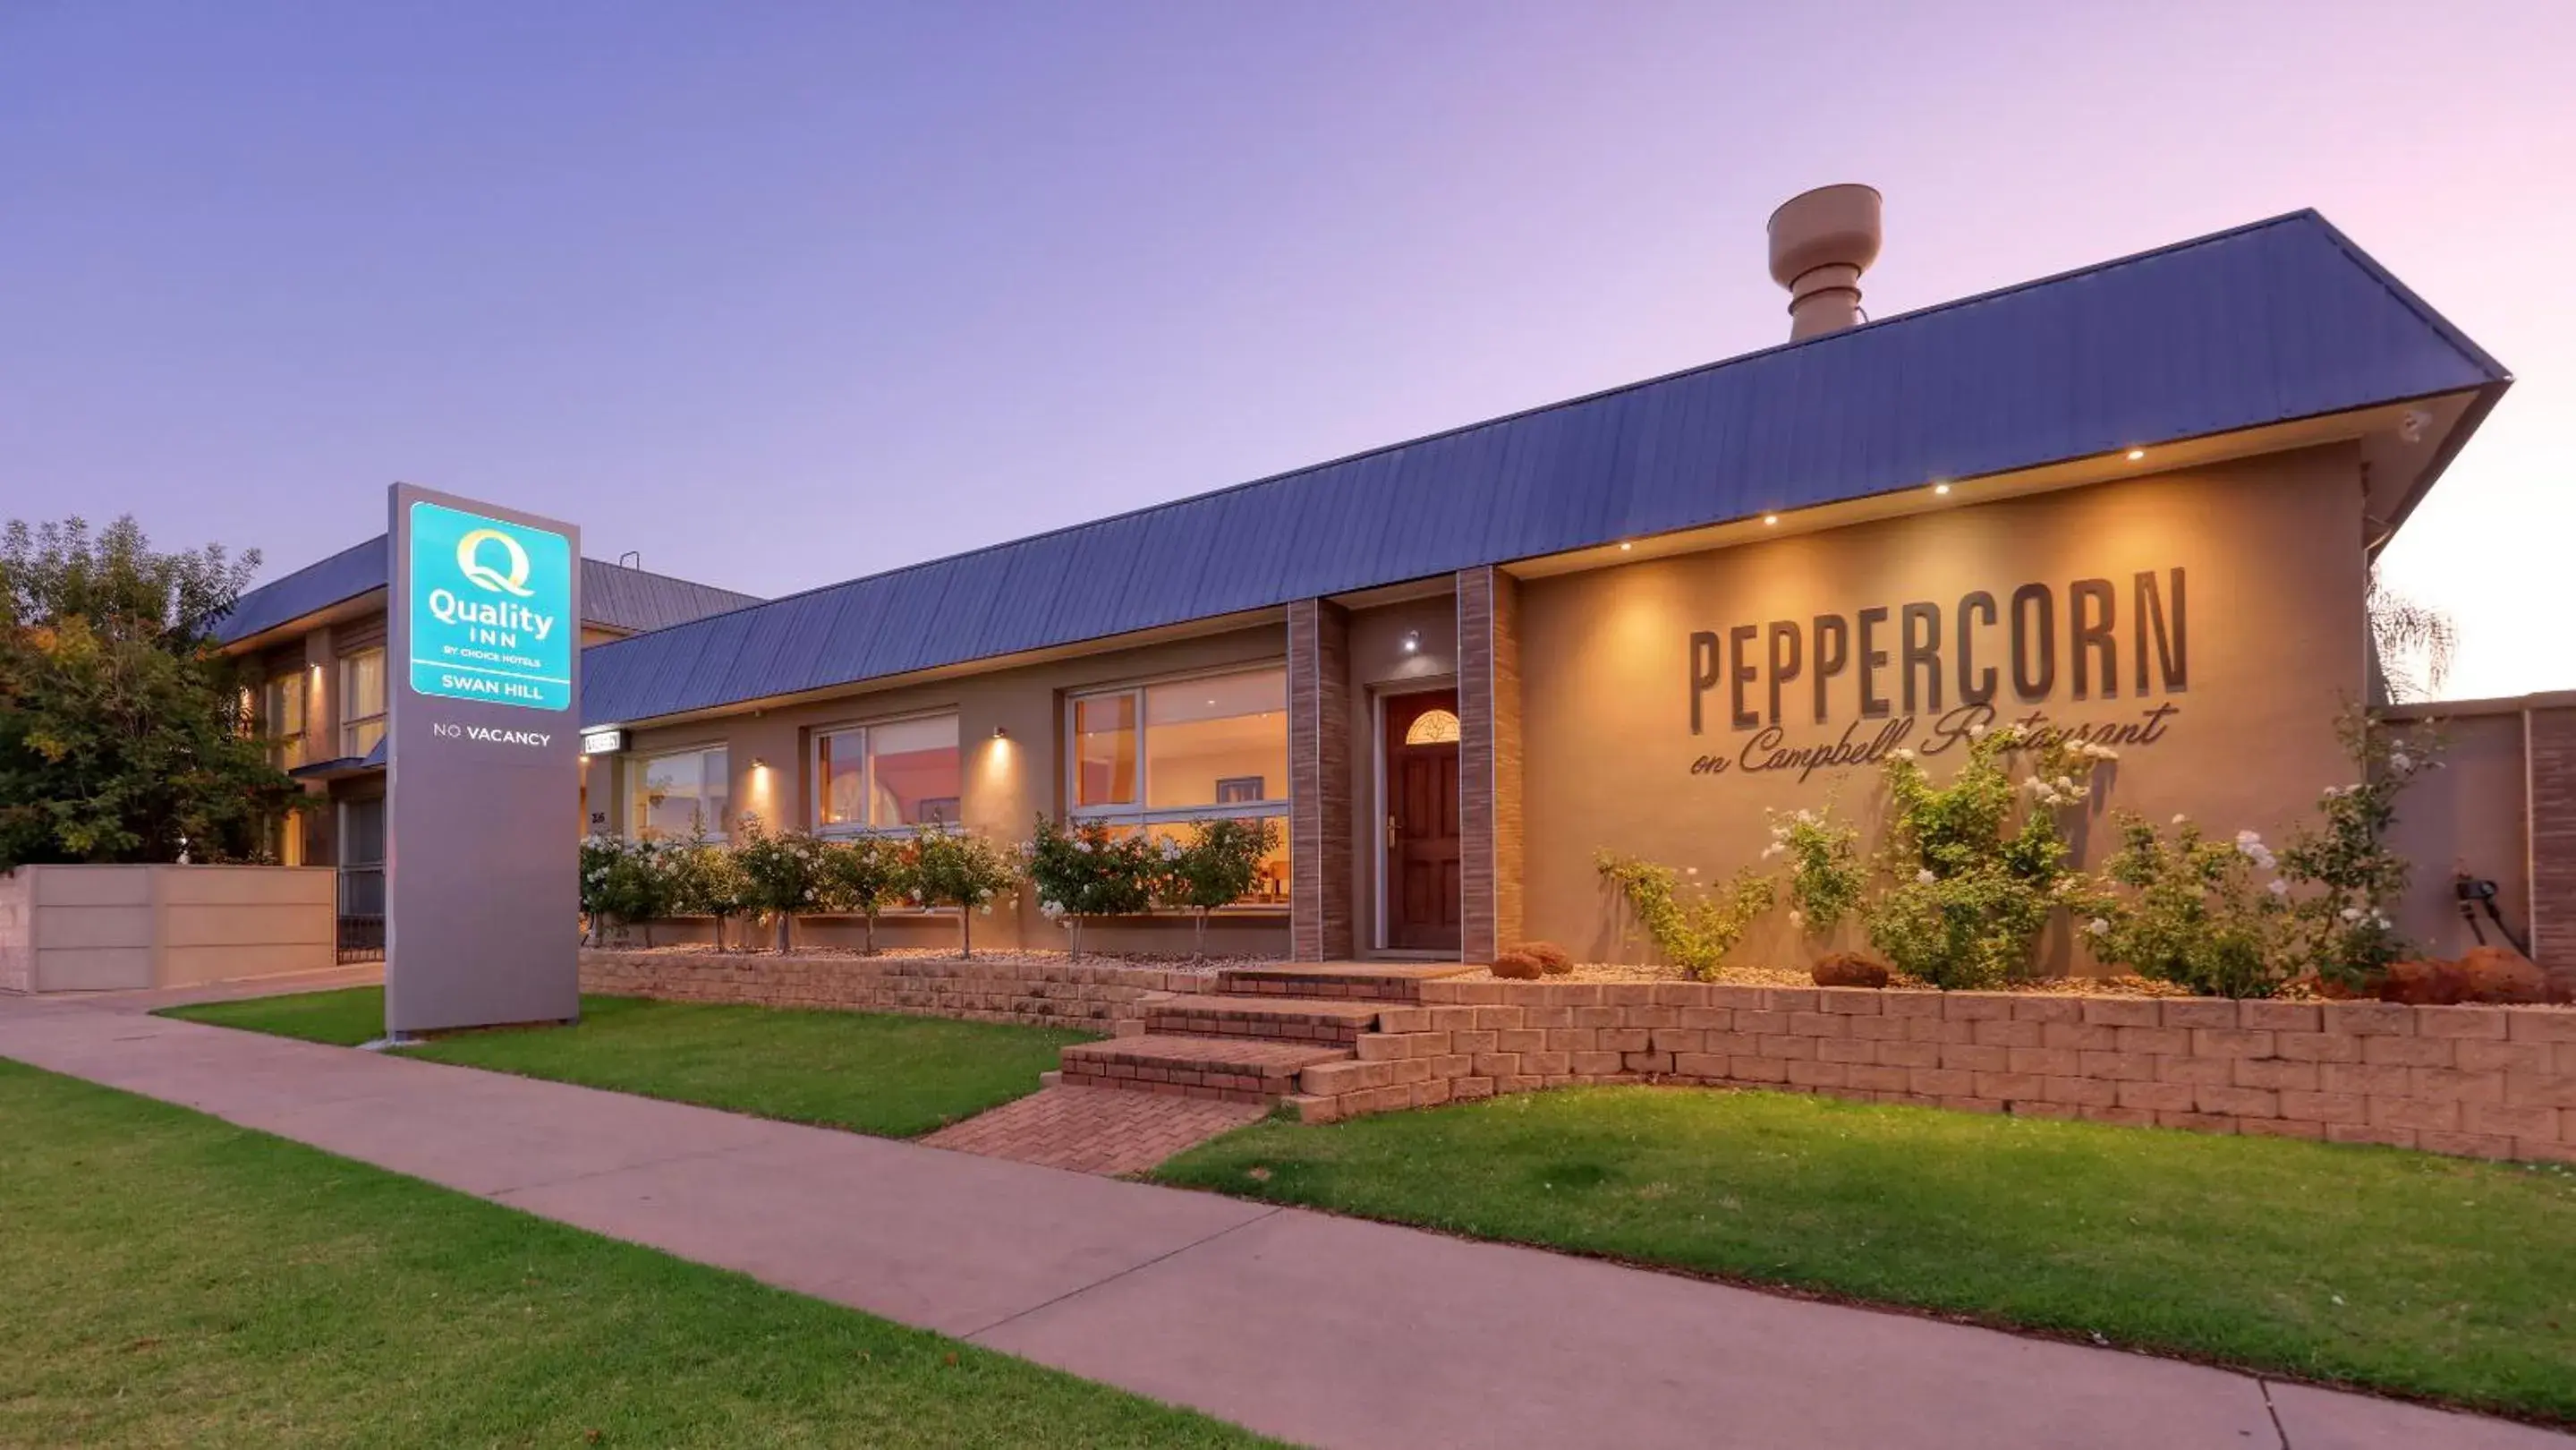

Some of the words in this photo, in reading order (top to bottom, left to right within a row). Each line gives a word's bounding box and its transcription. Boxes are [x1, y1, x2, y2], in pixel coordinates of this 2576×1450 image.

[456, 527, 536, 597] Q
[429, 588, 555, 640] Quality
[444, 645, 458, 655] BY
[461, 648, 499, 661] CHOICE
[502, 654, 541, 668] HOTELS
[469, 626, 516, 649] INN
[1689, 567, 2188, 735] PEPPERCORN
[442, 674, 499, 695] SWAN
[504, 683, 543, 700] HILL
[433, 722, 461, 738] NO
[466, 726, 550, 746] VACANCY
[1690, 755, 1732, 776] on
[1739, 716, 1915, 784] Campbell
